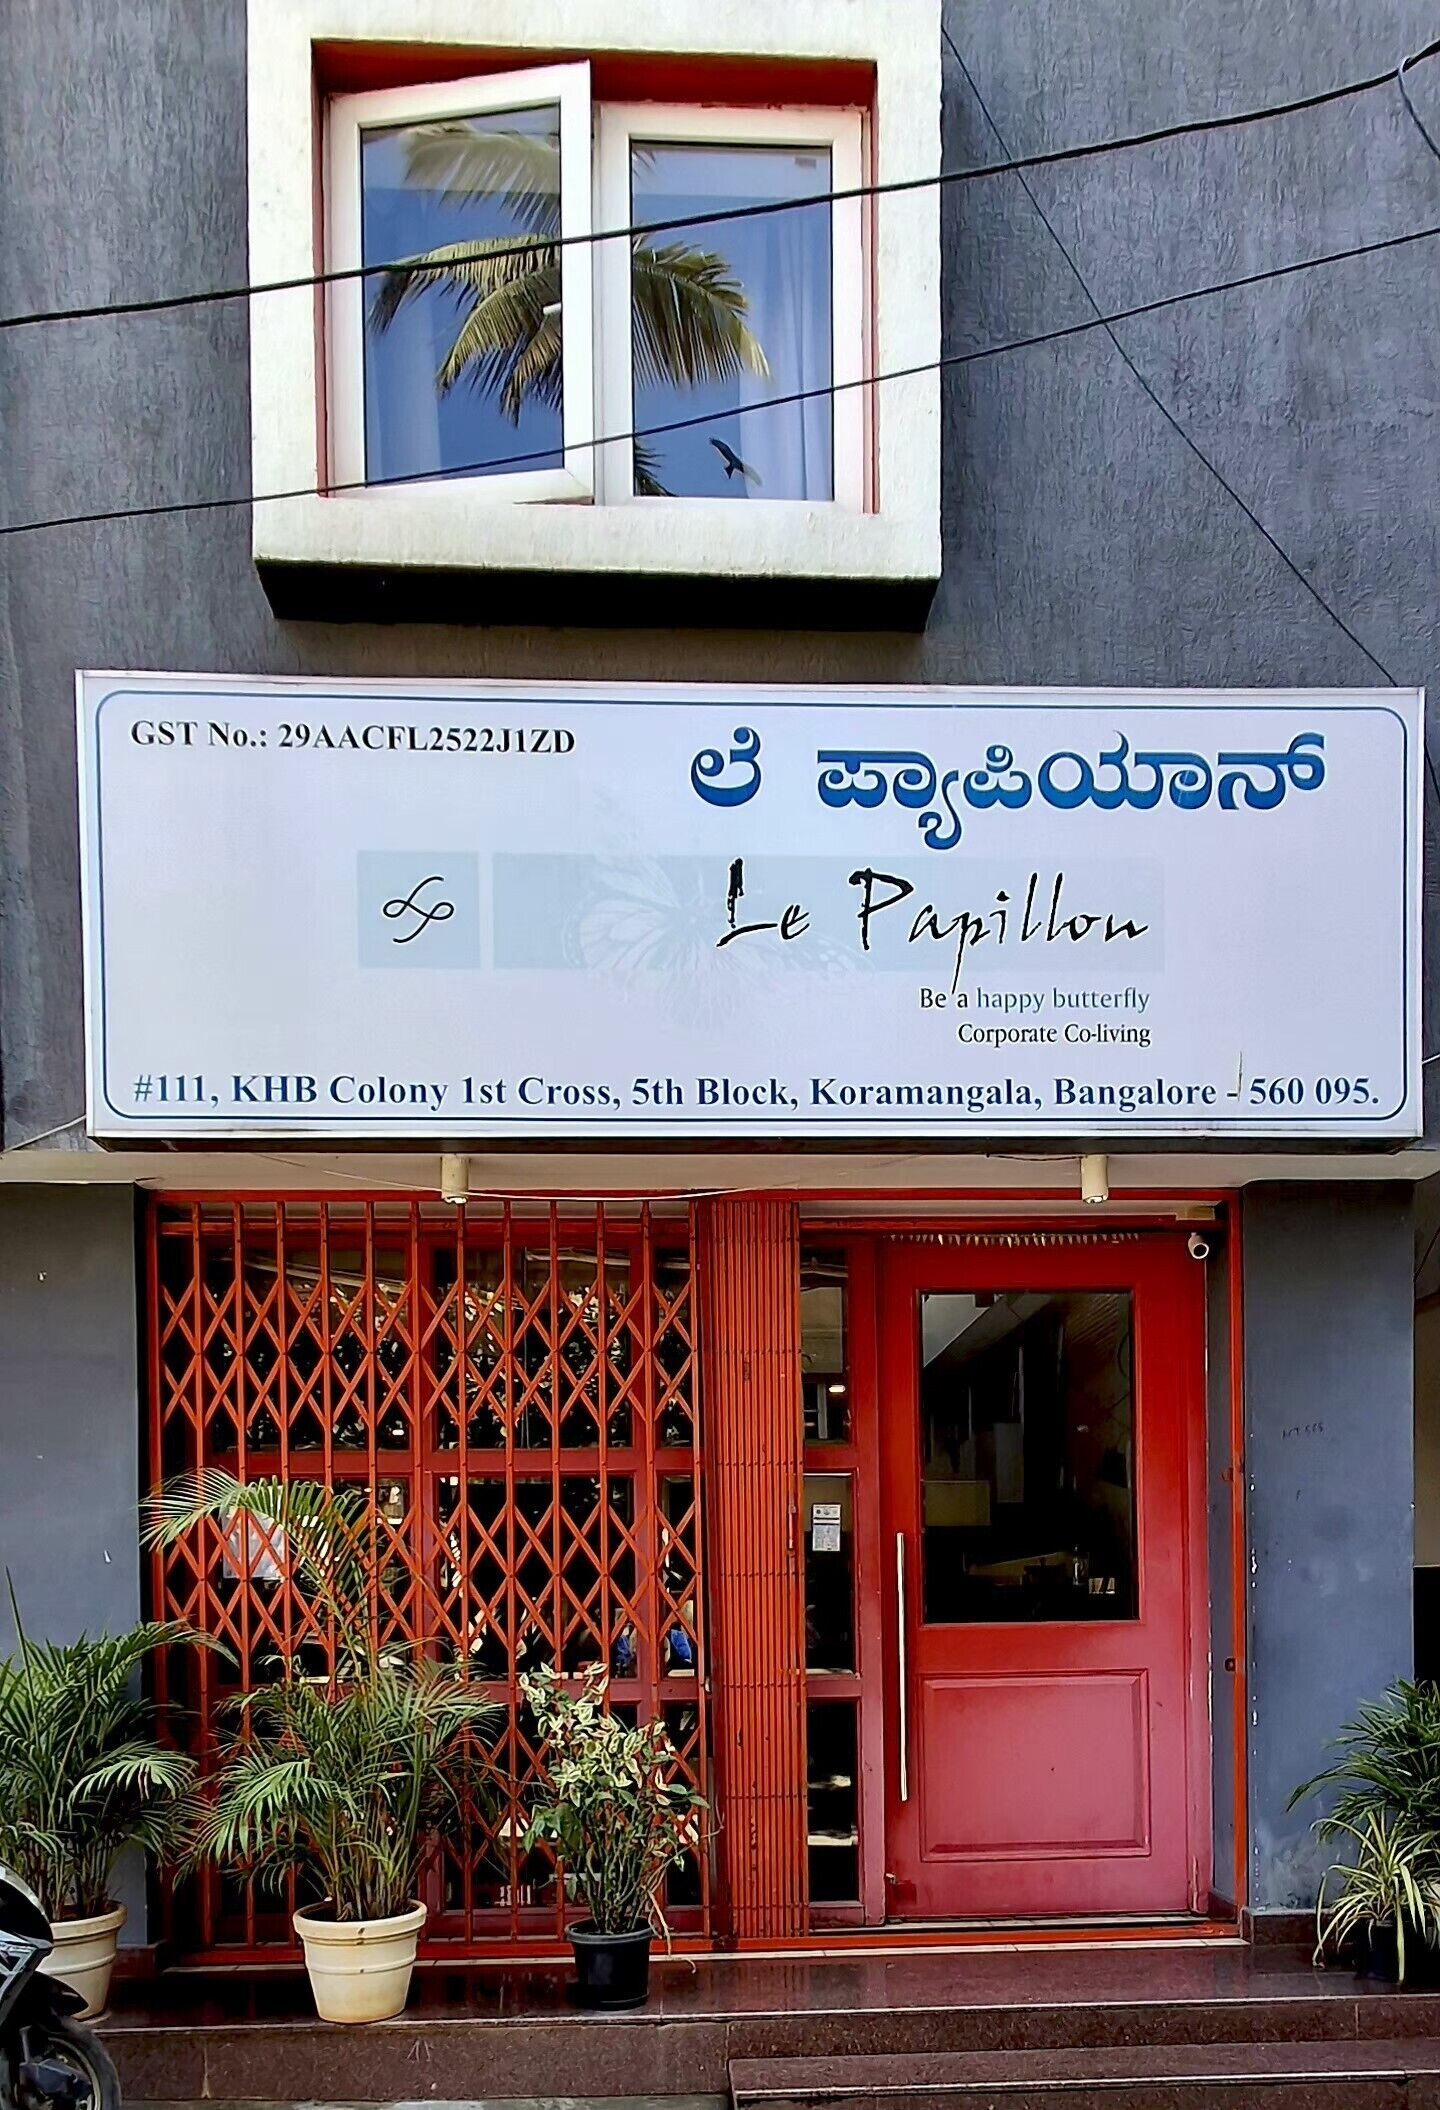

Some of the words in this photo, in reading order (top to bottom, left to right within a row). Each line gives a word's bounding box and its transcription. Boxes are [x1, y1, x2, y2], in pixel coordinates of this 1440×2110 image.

[131, 719, 199, 747] GST
[207, 722, 268, 748] No.:
[278, 723, 576, 754] 29AACFL2522J1ZD
[690, 726, 762, 808] ಲೆ
[817, 730, 1326, 851] ಪ್ಯಾಪಿಯಾನ್
[716, 857, 811, 948] Le
[848, 866, 1149, 995] Papillon
[920, 987, 947, 1009] Be
[957, 993, 969, 1009] a
[977, 986, 1045, 1014] happy
[1053, 986, 1150, 1014] butterfly
[958, 1023, 1057, 1048] Corporate
[1065, 1023, 1151, 1048] Co-living
[133, 1074, 219, 1109] #111,
[232, 1075, 318, 1103] KHB
[329, 1075, 449, 1112] Colony
[461, 1076, 507, 1105] 1st
[517, 1076, 621, 1111] Cross,
[632, 1077, 684, 1106] 5th
[695, 1077, 799, 1111] Block,
[809, 1078, 1042, 1113] Koramangala,
[1053, 1077, 1217, 1113] Bangalore
[1249, 1077, 1304, 1105] 560
[1315, 1077, 1380, 1105] 095.
